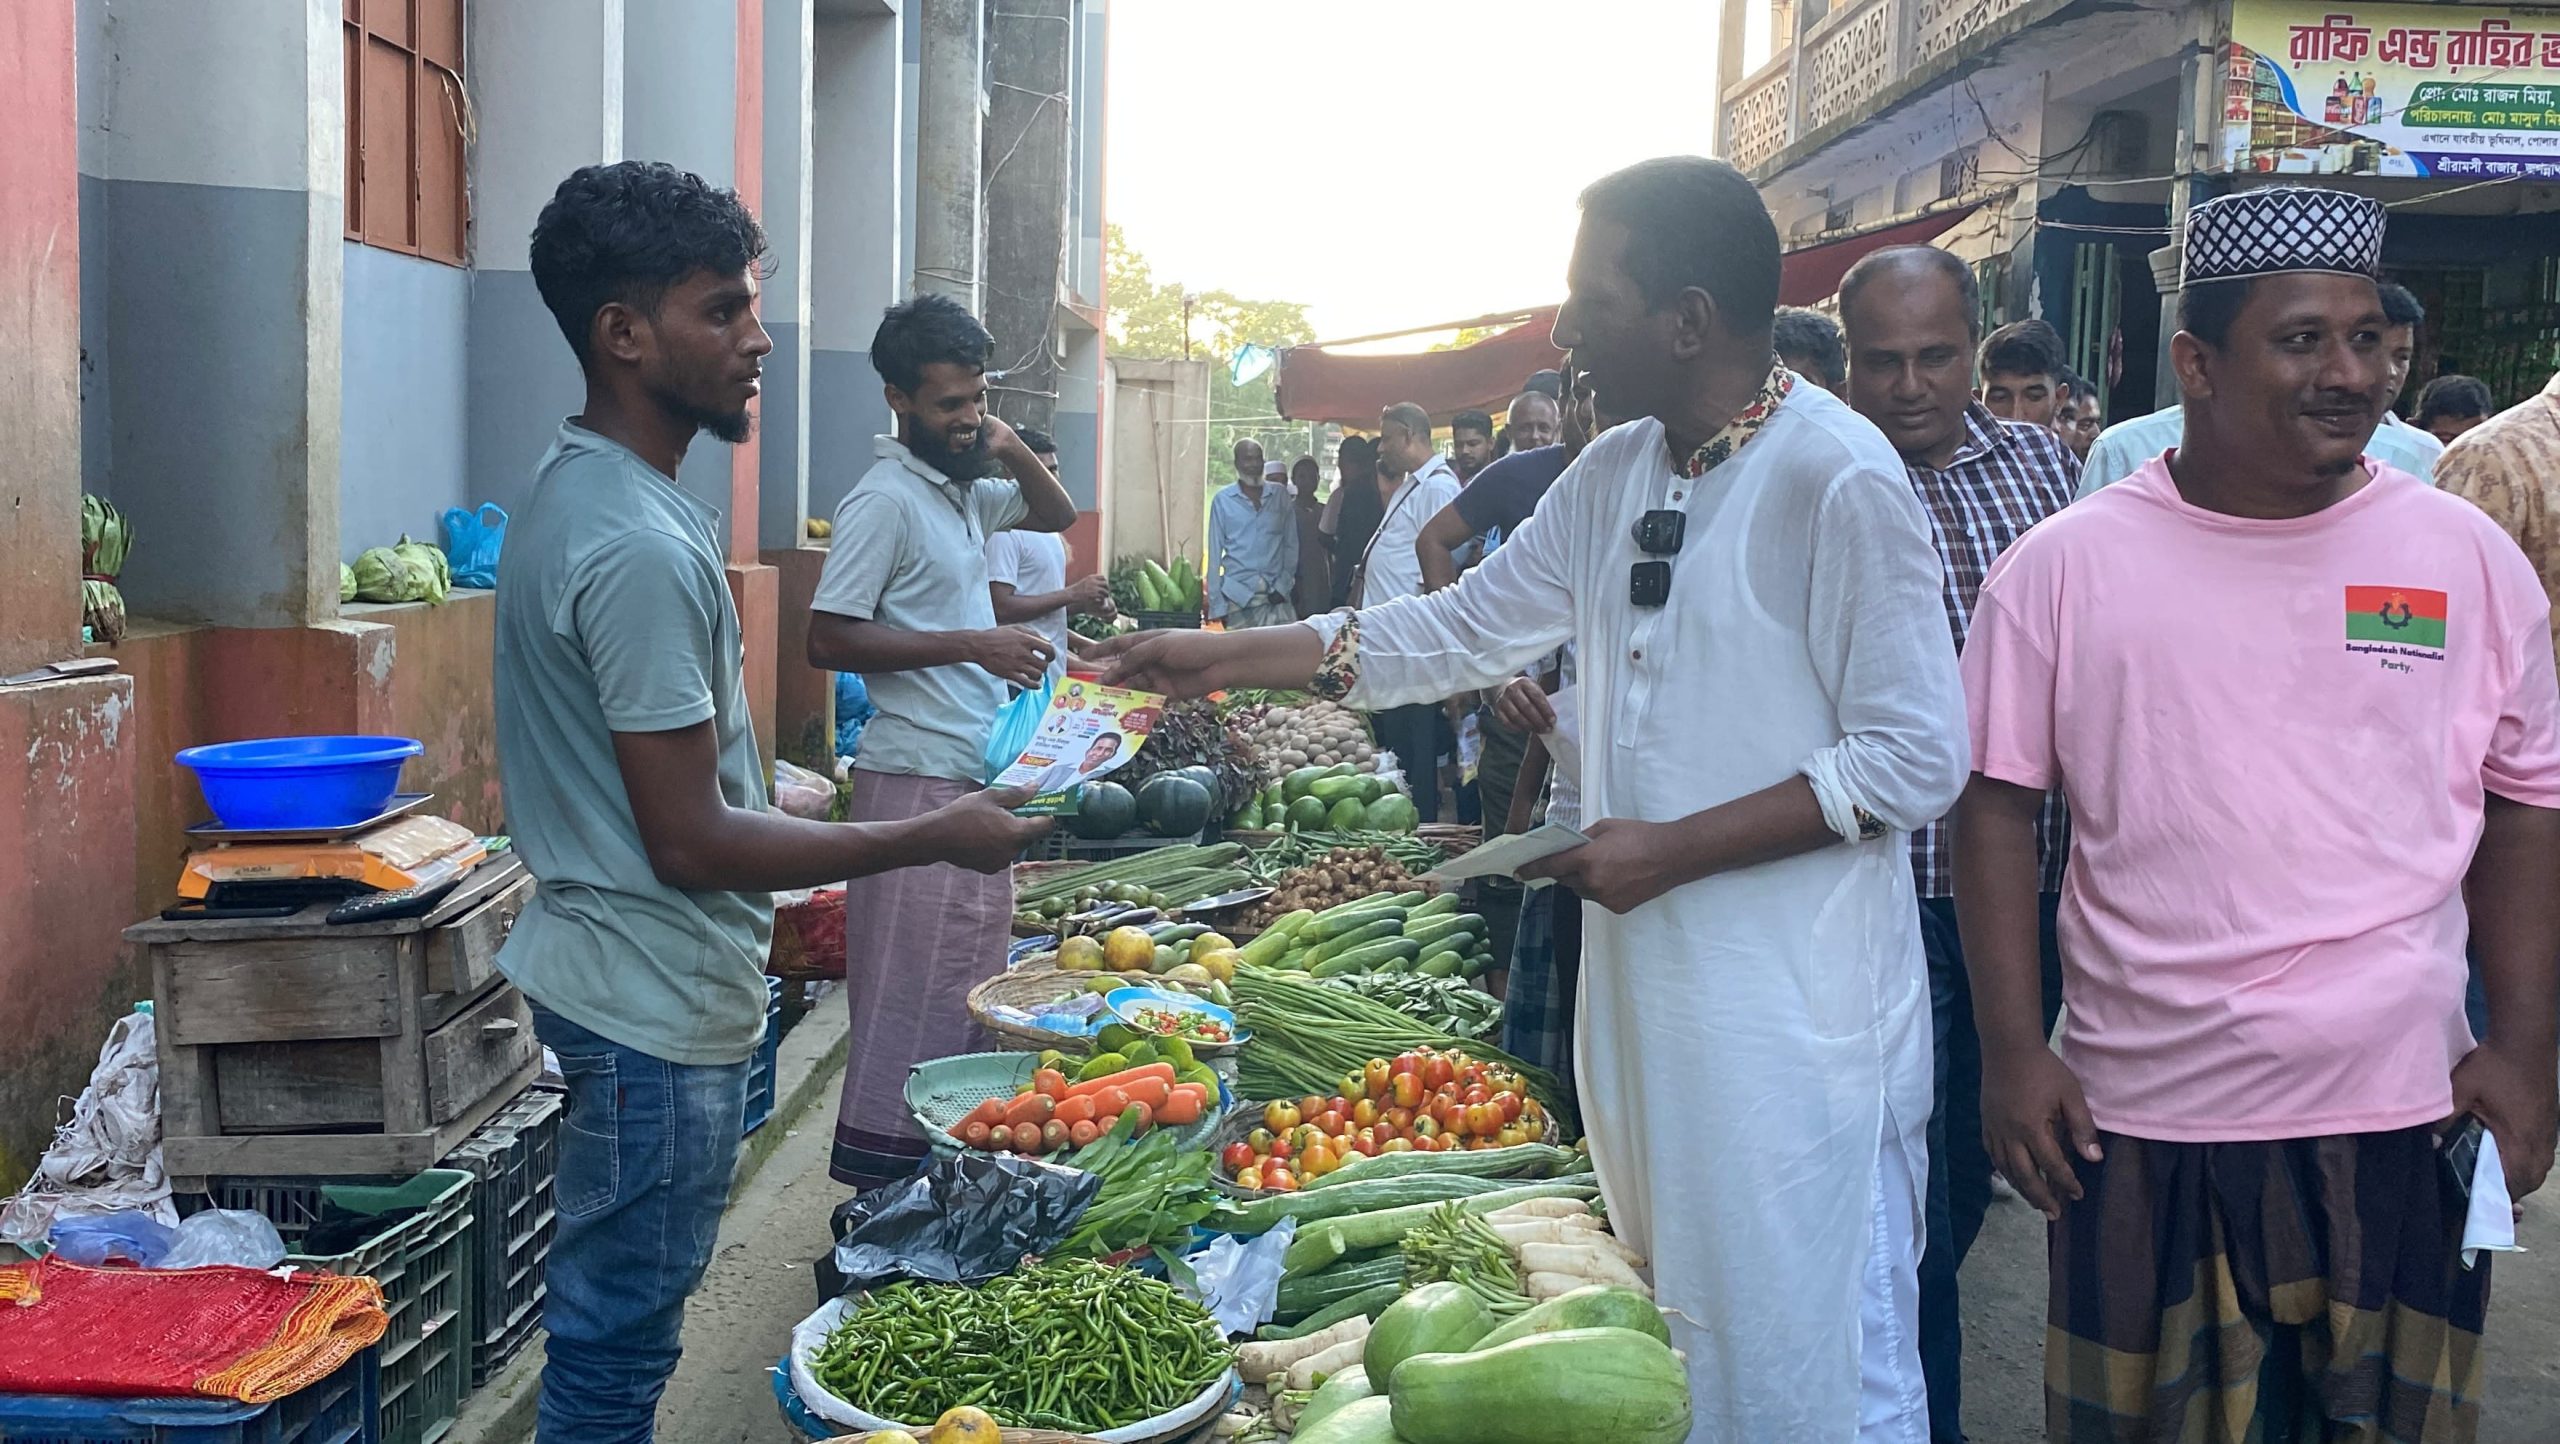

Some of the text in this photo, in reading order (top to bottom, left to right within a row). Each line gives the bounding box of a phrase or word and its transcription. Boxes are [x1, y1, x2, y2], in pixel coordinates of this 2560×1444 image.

[2289, 15, 2371, 69] রাফি
[2379, 28, 2440, 68] এন্ড
[2483, 89, 2519, 104] রাজন
[2510, 112, 2541, 128] মাসুদ
[2346, 643, 2444, 661] Bangladesh Nationalist
[2381, 659, 2414, 674] Party.
